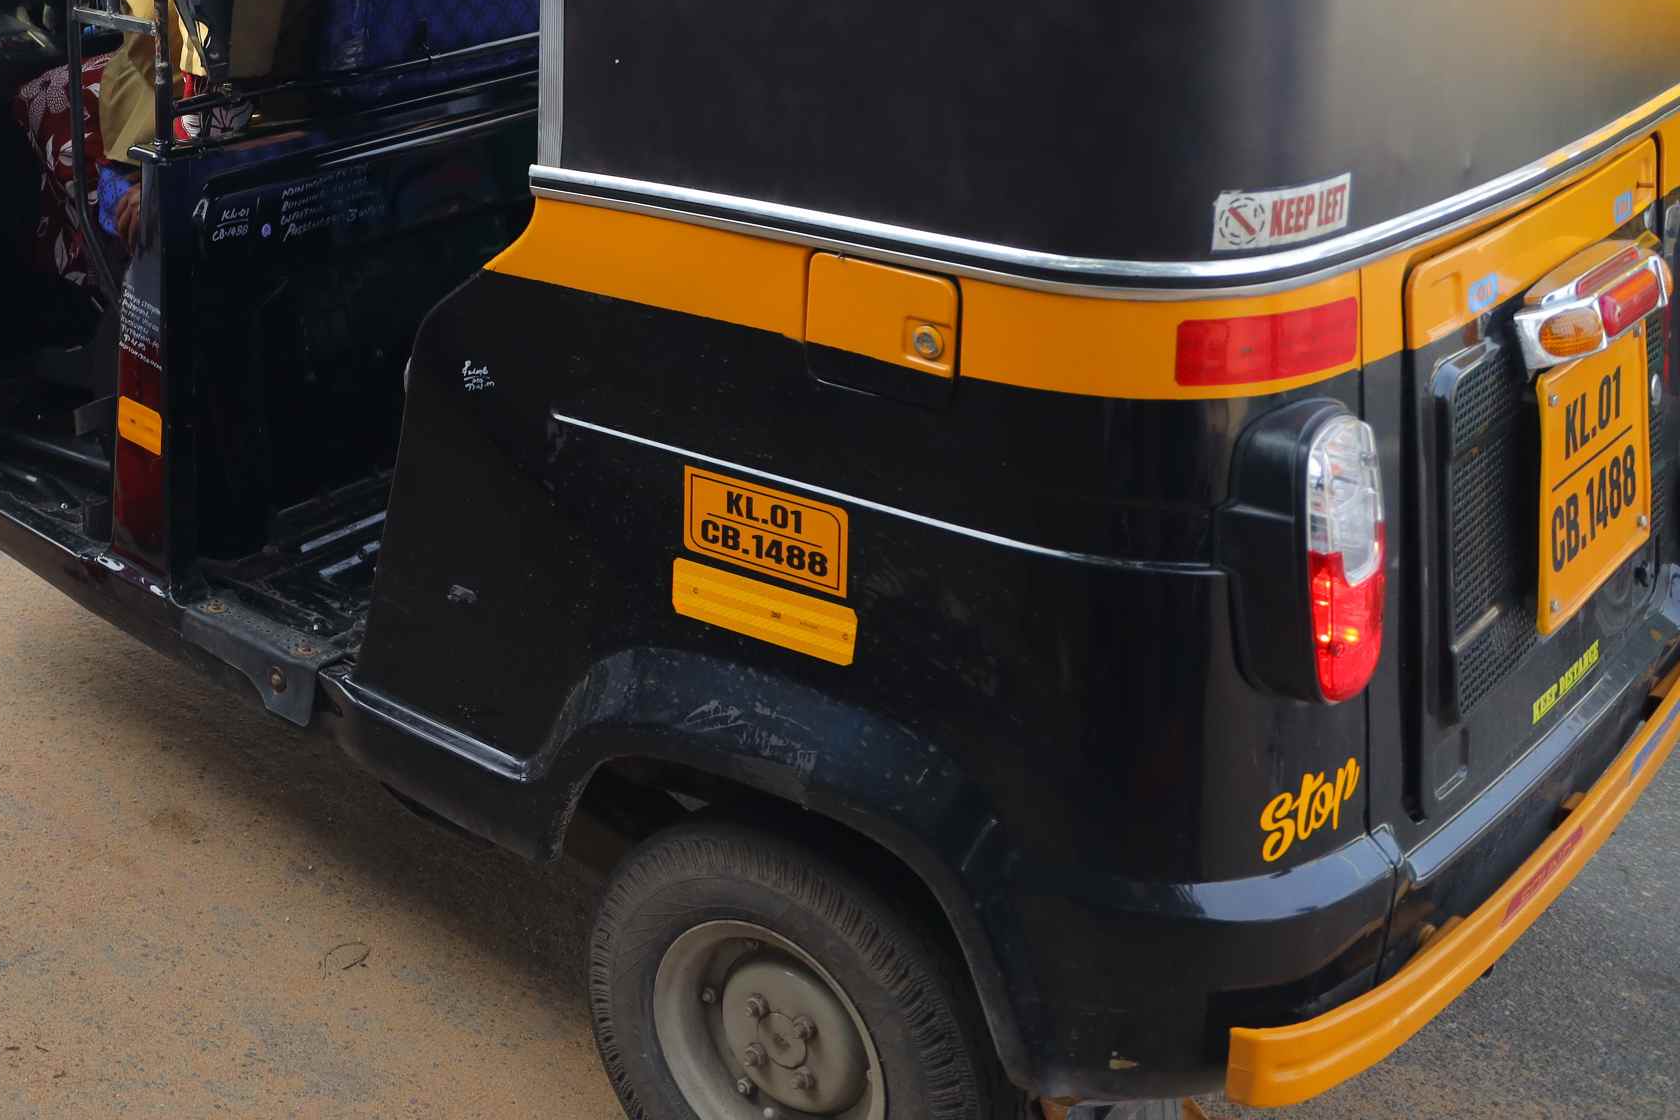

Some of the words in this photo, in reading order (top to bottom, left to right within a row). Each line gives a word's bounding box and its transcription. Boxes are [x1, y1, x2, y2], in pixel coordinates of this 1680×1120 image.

[1270, 193, 1315, 237] KEEP
[1317, 184, 1347, 227] LEFT
[1565, 365, 1622, 461] KL.01
[701, 520, 828, 577] CB.1488
[726, 491, 802, 535] KL.01
[1551, 444, 1637, 573] CB.1488
[1532, 682, 1558, 725] KEEP
[1559, 640, 1600, 695] DISTANCE
[1260, 757, 1360, 862] Stop
